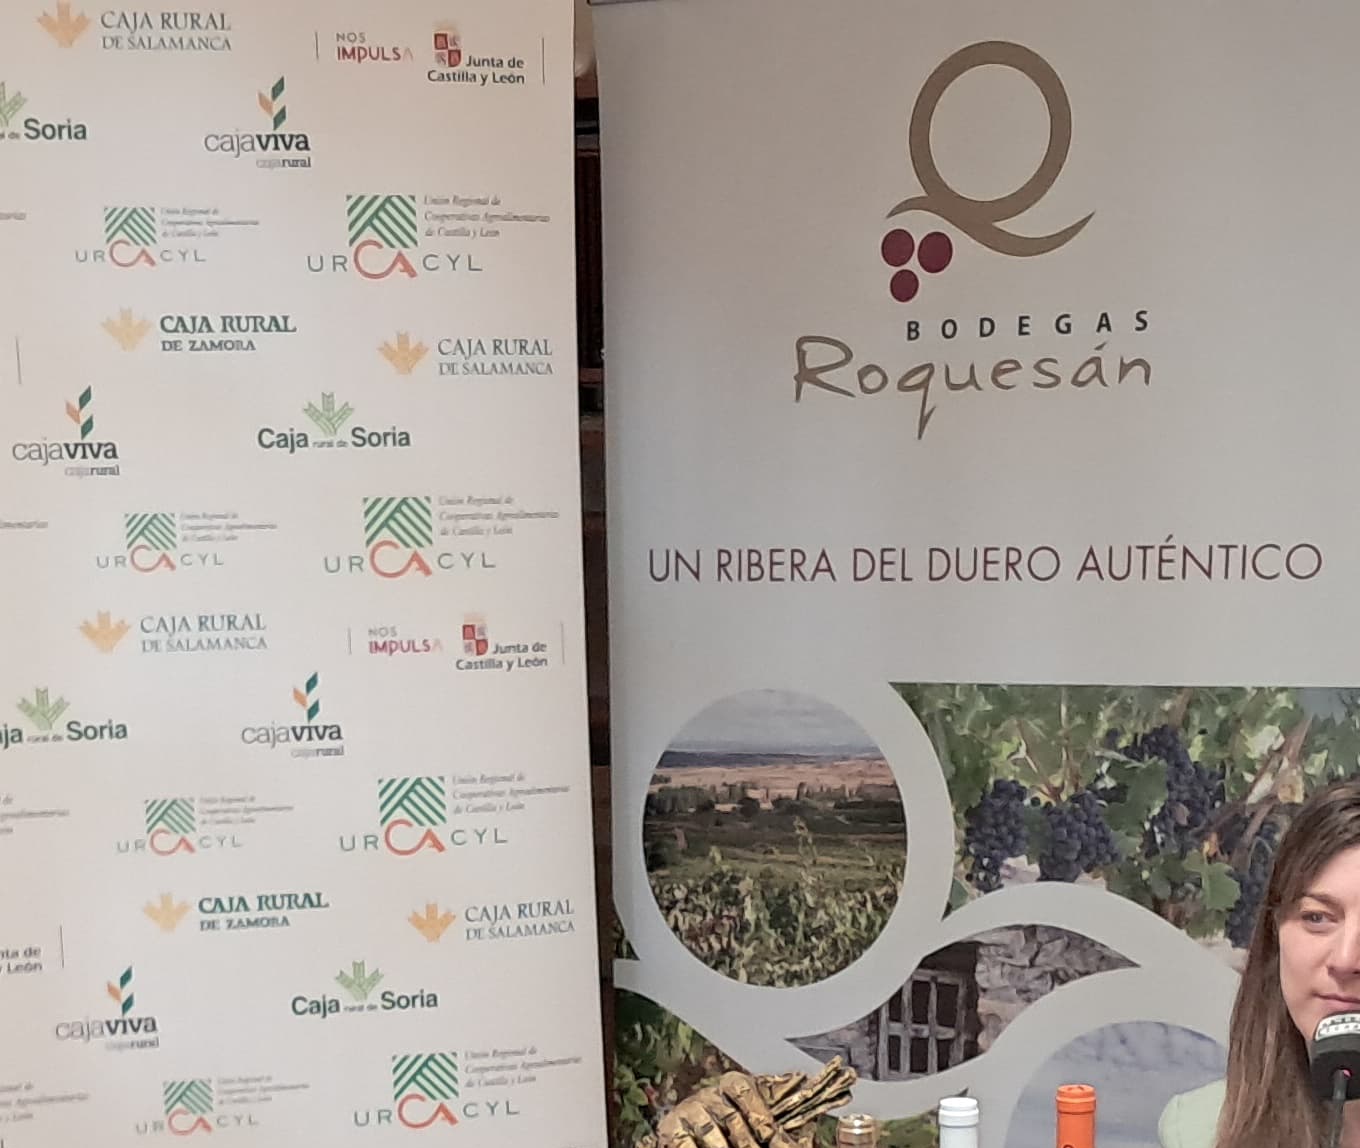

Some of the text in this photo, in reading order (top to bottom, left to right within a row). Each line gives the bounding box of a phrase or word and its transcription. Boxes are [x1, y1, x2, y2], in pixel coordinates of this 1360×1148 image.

[101, 11, 231, 33] CAJA RURAL
[102, 36, 232, 52] DE SALAMANCA
[336, 31, 366, 43] NOS
[337, 45, 414, 63] IMPULSA
[465, 55, 525, 70] Junta de
[427, 69, 526, 86] Castilla y León
[23, 118, 88, 141] Soria
[203, 130, 312, 158] cajaviva
[159, 315, 297, 334] CAJA RURAL
[905, 310, 1150, 342] BODEGAS
[161, 340, 257, 352] DE ZAMORA
[438, 338, 553, 358] CAJA RURAL
[439, 362, 554, 376] DE SALAMANCA
[793, 335, 1152, 440] Roquesán
[257, 426, 412, 454] Caja Soria
[12, 440, 119, 466] cajaviva
[649, 535, 1323, 583] UN RIBERA DEL DUERO AUTÉNTICO
[140, 613, 267, 635] CAJA RURAL
[142, 636, 269, 653] DE SALAMANCA
[492, 641, 547, 656] Junta de
[455, 656, 548, 673] Castilla y León
[66, 719, 128, 741] Soria
[241, 723, 344, 748] cajaviva
[198, 891, 330, 914] CAJA RURAL
[465, 898, 575, 925] CAJA RURAL
[199, 919, 221, 932] DE
[465, 928, 486, 941] DE
[23, 946, 41, 959] de
[291, 989, 438, 1019] Caja Soria
[55, 1015, 158, 1044] cajaviva
